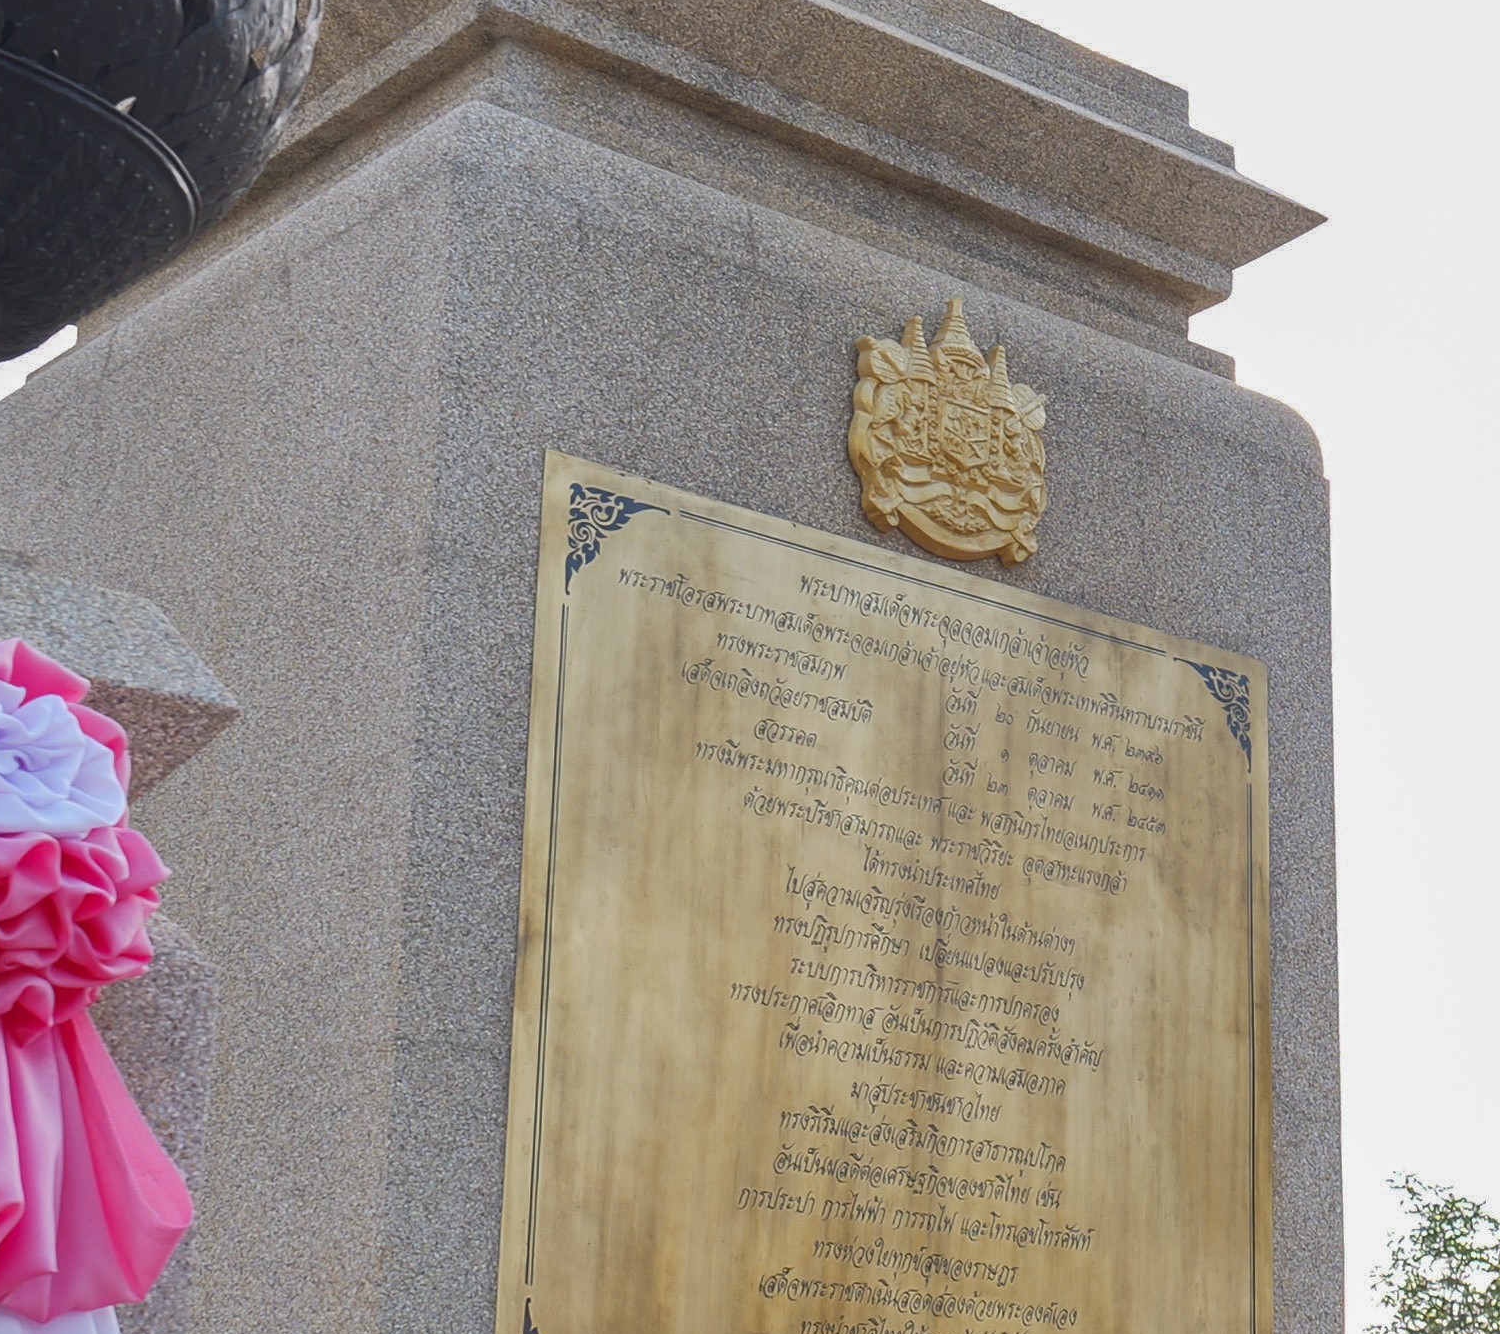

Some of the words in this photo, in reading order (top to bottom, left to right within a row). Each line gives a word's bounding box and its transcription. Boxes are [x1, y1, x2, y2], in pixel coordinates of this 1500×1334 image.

[944, 677, 983, 716] วันที่
[993, 701, 1014, 726] ๒๐
[1024, 707, 1081, 743] กันยายน
[1090, 731, 1123, 754] พ.ศ.
[1123, 735, 1164, 765] ๒๓๙๖
[752, 716, 818, 749] สวรรคต
[940, 756, 979, 788] วันที่
[985, 770, 1009, 797] ๒๓
[1026, 785, 1076, 813] ตุลาคม
[1090, 801, 1122, 823] พ.ศ.
[1125, 805, 1166, 836] ๒๔๕๓
[942, 721, 982, 752] วันที่
[999, 747, 1010, 763] ๑
[1027, 751, 1078, 779] ตุลาคม
[1091, 767, 1124, 789] พ.ศ.
[1126, 771, 1165, 802] ๒๔๑๑
[946, 796, 977, 825] และ
[736, 1185, 816, 1215] การประปา
[819, 1188, 887, 1225] การไฟฟ้า
[890, 1201, 959, 1235] การรถไฟ
[1034, 1179, 1064, 1210] เช่น
